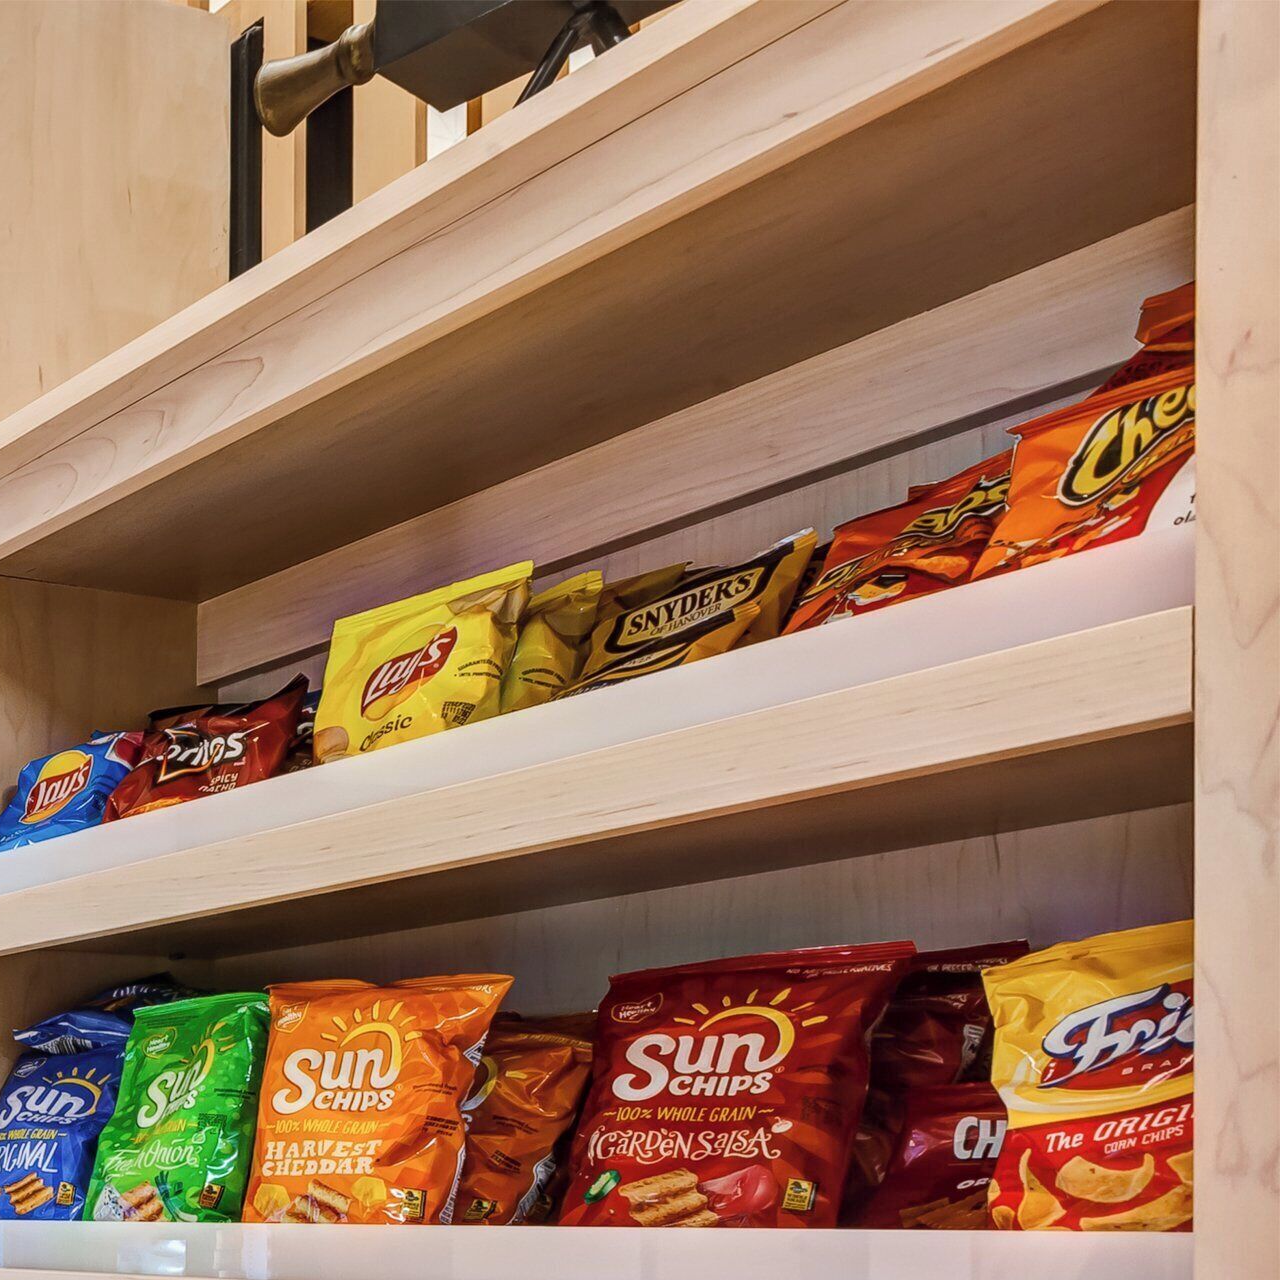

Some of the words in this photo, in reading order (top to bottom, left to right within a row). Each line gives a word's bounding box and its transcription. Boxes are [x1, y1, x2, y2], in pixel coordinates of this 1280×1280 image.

[627, 572, 755, 637] SNYDER'S
[650, 625, 668, 636] OF
[669, 603, 721, 630] HANOVER
[364, 635, 452, 708] Lay's
[359, 715, 413, 752] Classic
[35, 763, 90, 812] Lay's
[209, 772, 239, 786] SPICY
[612, 1032, 784, 1102] Sun
[272, 1049, 401, 1115] Sun
[668, 1072, 774, 1097] CHIPS
[314, 1089, 395, 1112] CHIPS
[616, 1107, 652, 1122] 100%
[657, 1106, 706, 1122] WHOLE
[709, 1106, 757, 1122] GRAIN
[16, 1111, 78, 1125] CHIPS
[275, 1120, 301, 1134] 100%
[302, 1119, 342, 1134] WHOLE
[343, 1120, 379, 1134] GRAIN
[1045, 1130, 1084, 1154] The
[1093, 1103, 1193, 1142] ORIGI
[30, 1128, 59, 1140] GRAIN
[1104, 1136, 1137, 1155] CORN
[1142, 1124, 1184, 1145] CHIPS
[265, 1139, 382, 1160] HARVEST
[261, 1157, 376, 1178] CHEDDAR
